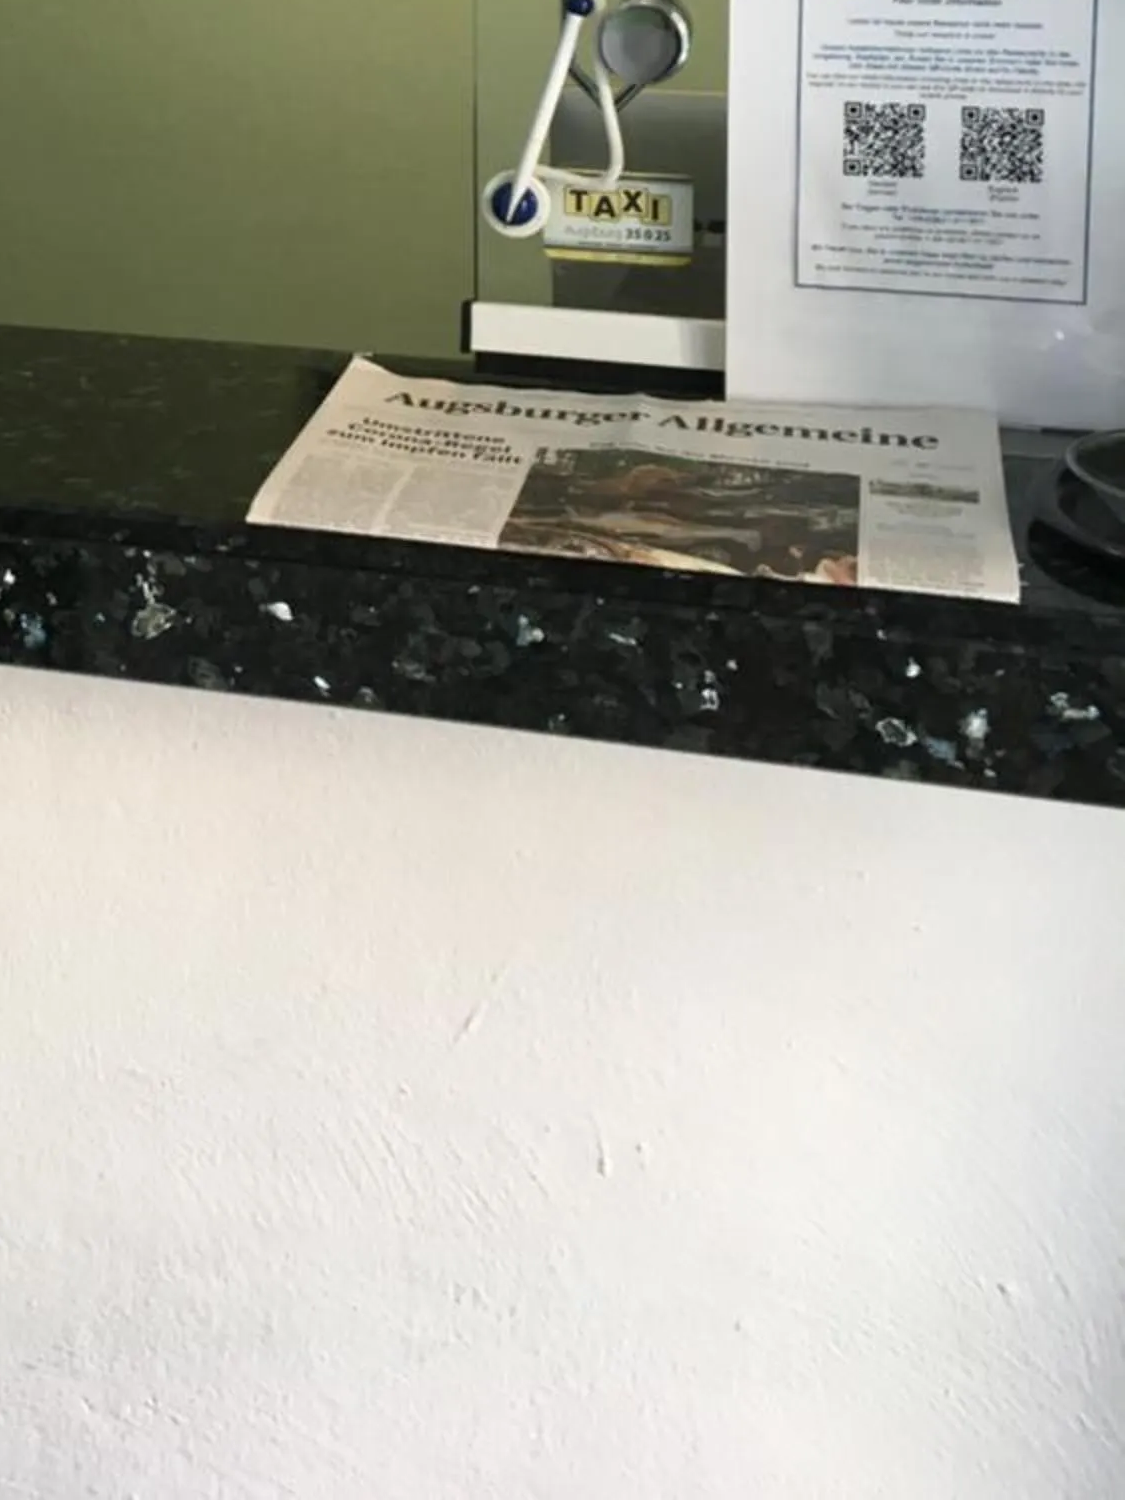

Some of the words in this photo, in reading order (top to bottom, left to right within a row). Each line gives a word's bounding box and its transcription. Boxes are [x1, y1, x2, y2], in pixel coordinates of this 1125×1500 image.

[569, 189, 660, 221] TAXI
[326, 428, 375, 444] zum
[383, 392, 651, 427] Augsburger
[658, 415, 940, 451] Allgemeine
